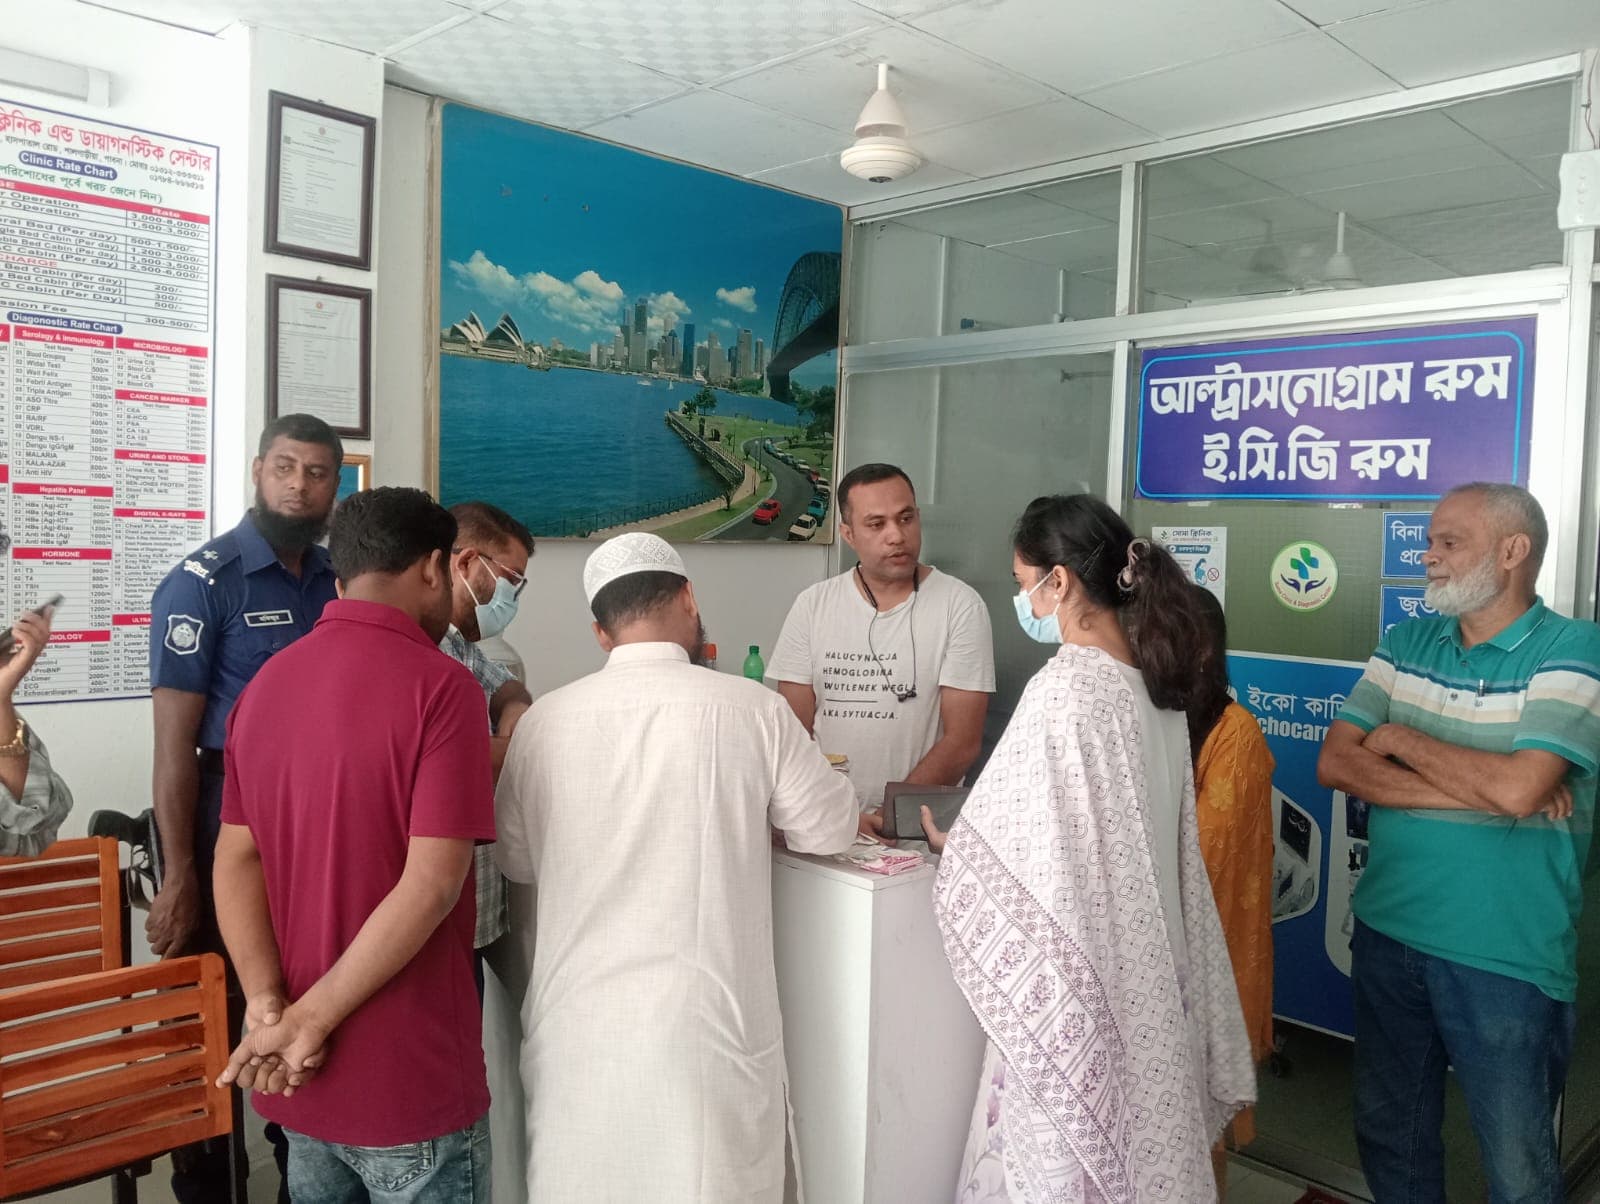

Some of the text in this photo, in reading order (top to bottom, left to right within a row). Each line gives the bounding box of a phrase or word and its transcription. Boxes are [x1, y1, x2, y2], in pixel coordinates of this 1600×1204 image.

[48, 124, 75, 142] এন্ড
[79, 129, 165, 162] ডায়াগনস্টিক
[169, 147, 212, 171] সেন্টার
[20, 153, 114, 180] Clinic Rate Chart
[10, 191, 79, 209] Operation
[10, 201, 80, 218] Operation
[152, 207, 180, 217] Rate
[18, 229, 39, 238] Bed
[42, 233, 72, 243] Cabin
[74, 237, 96, 247] (Per
[98, 241, 119, 252] day)
[26, 220, 53, 230] Bed
[57, 226, 84, 236] (Per
[89, 231, 117, 241] day)
[17, 247, 57, 258] Cabin
[60, 253, 87, 264] (Per
[91, 258, 119, 269] day)
[21, 238, 41, 247] Bed
[44, 241, 73, 252] Cabin
[75, 246, 95, 256] (Per
[98, 250, 118, 260] day)
[4, 263, 29, 272] Bed
[32, 267, 67, 277] Cabin
[70, 272, 94, 282] (Per
[98, 276, 122, 286] day)
[8, 272, 31, 281] Bed
[35, 276, 68, 287] Cabin
[72, 281, 95, 291] (Per
[98, 285, 122, 295] day)
[16, 283, 57, 294] Cabin
[61, 288, 88, 299] (Per
[93, 293, 122, 304] Day)
[43, 304, 68, 313] Fee
[70, 320, 91, 330] Rate
[93, 324, 118, 334] Chart
[22, 330, 54, 342] Serology
[62, 335, 105, 347] Immunology
[1149, 355, 1512, 421] আল্ট্রাসনোগ্রাম রুম
[1202, 425, 1431, 483] ই.সি.জি রুম
[1391, 520, 1425, 541] বিনা
[42, 551, 80, 559] HORMONE
[825, 651, 898, 662] HALUCYNACJA
[823, 667, 893, 677] HEMOGLOBINA
[1246, 683, 1298, 715] ইকো
